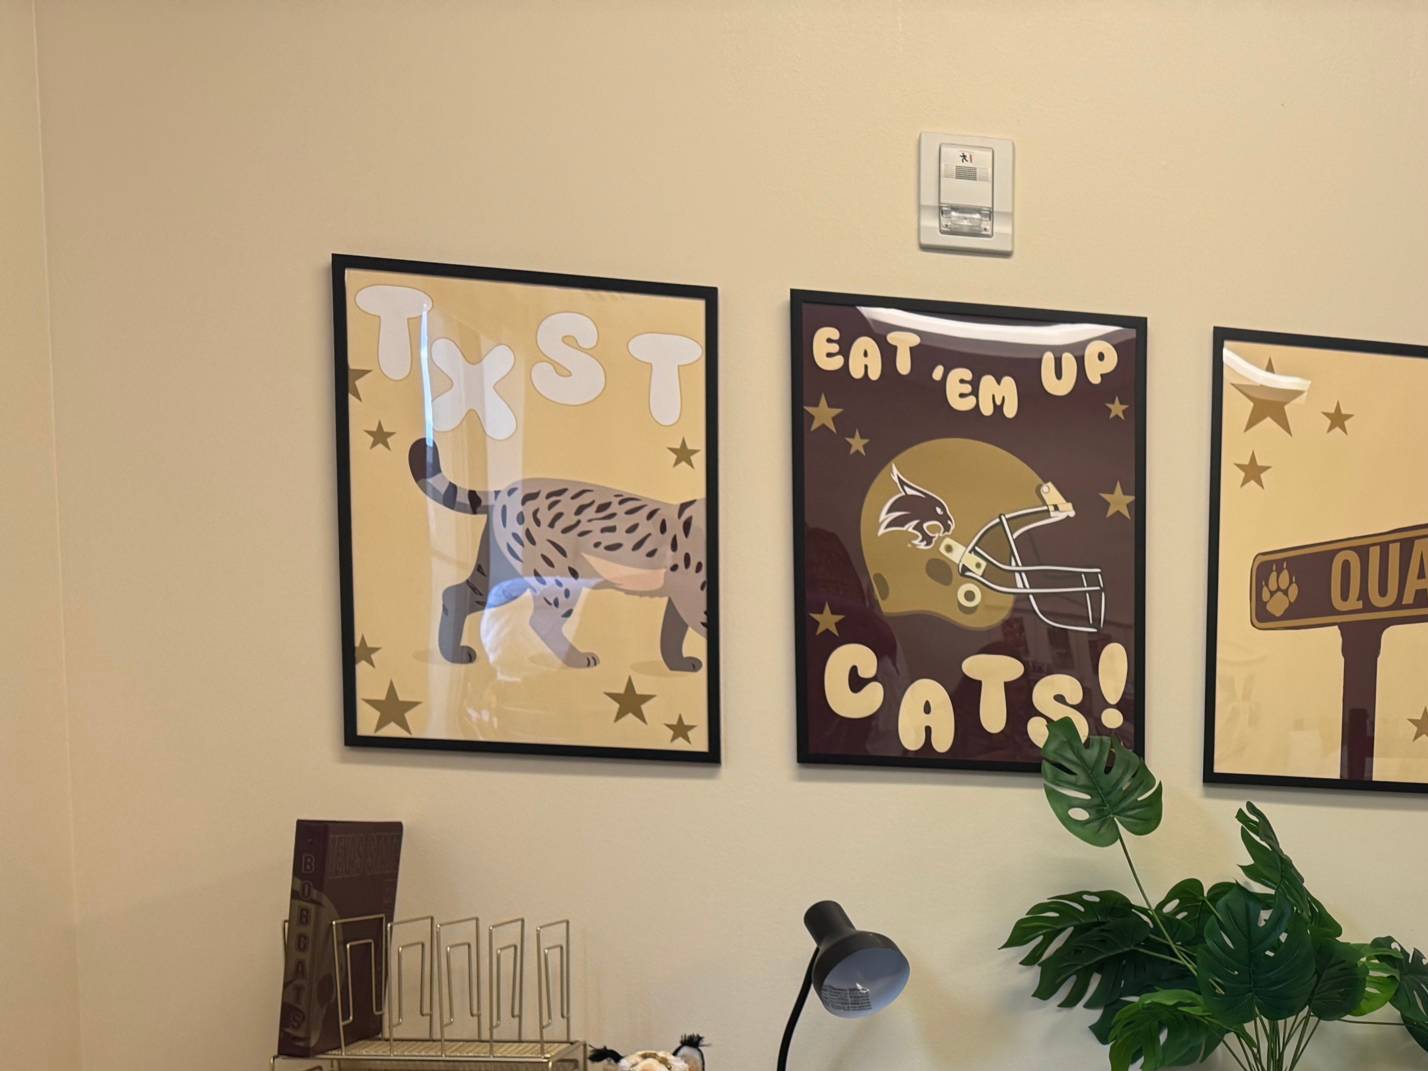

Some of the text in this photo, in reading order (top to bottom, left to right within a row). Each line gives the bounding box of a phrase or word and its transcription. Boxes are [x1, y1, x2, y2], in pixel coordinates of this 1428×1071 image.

[355, 284, 703, 440] TXST
[812, 326, 1119, 418] EAT 'EM UP
[824, 642, 1128, 752] CATS!
